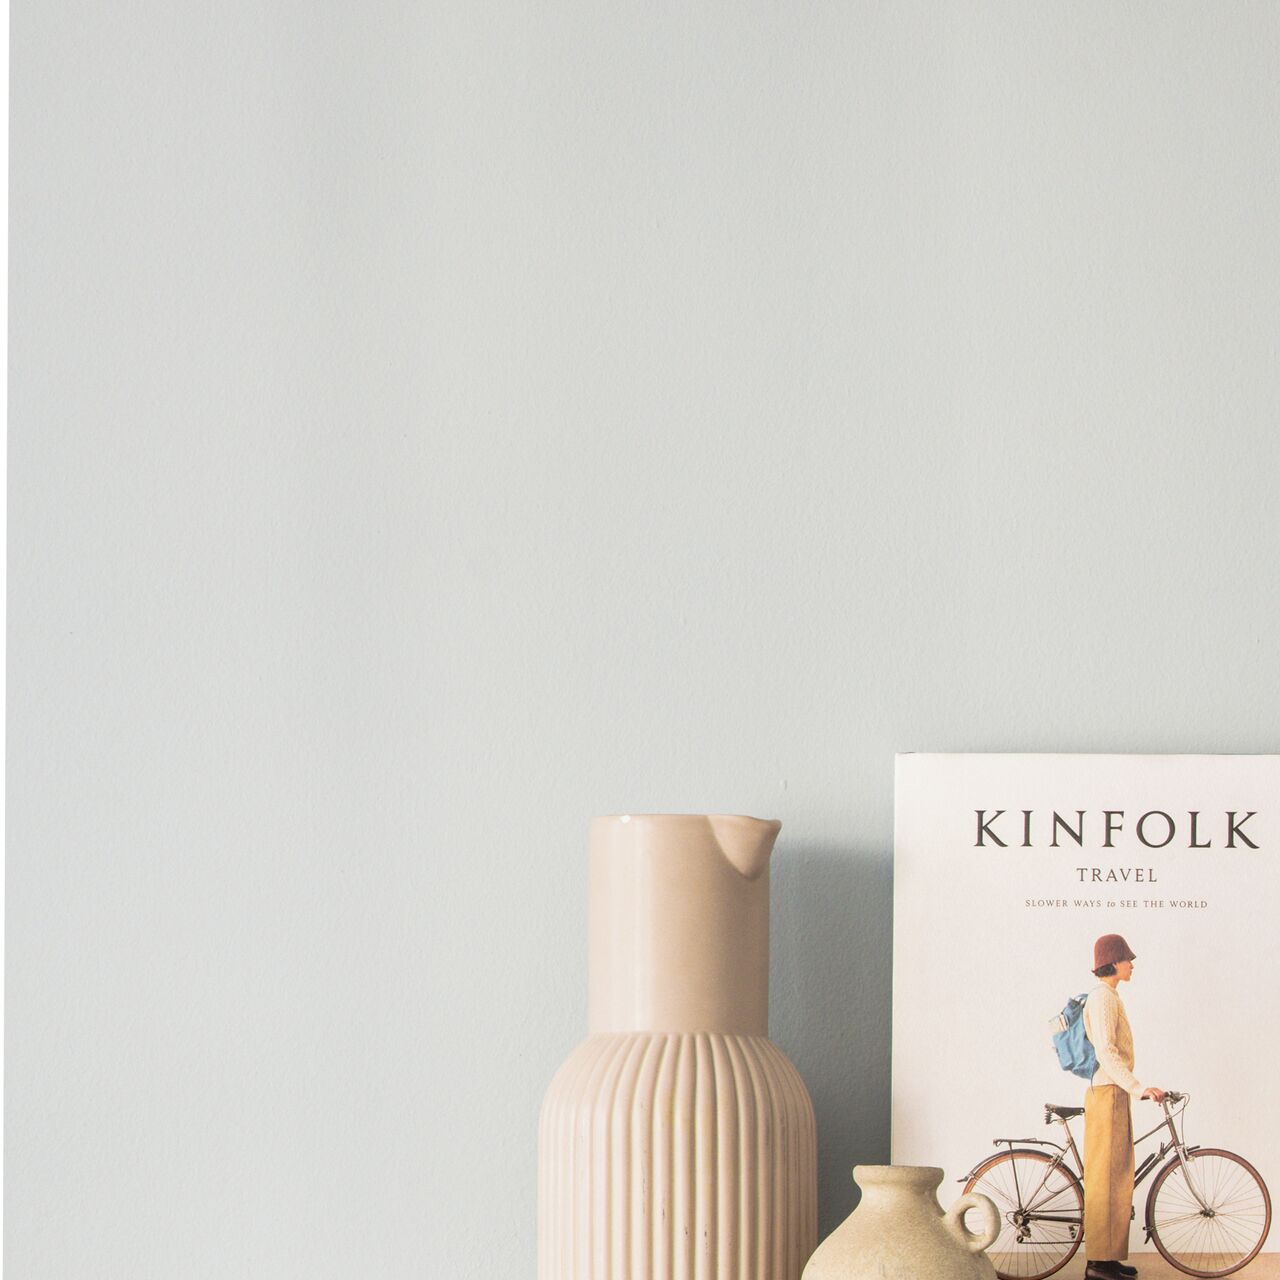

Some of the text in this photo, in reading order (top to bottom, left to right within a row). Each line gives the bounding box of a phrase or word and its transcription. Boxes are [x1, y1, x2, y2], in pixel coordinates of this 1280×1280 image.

[973, 809, 1261, 850] KINFOLK
[1076, 867, 1158, 883] TRAVEL
[1024, 899, 1208, 909] SLOWER WAYS to SEE THE WORLD
